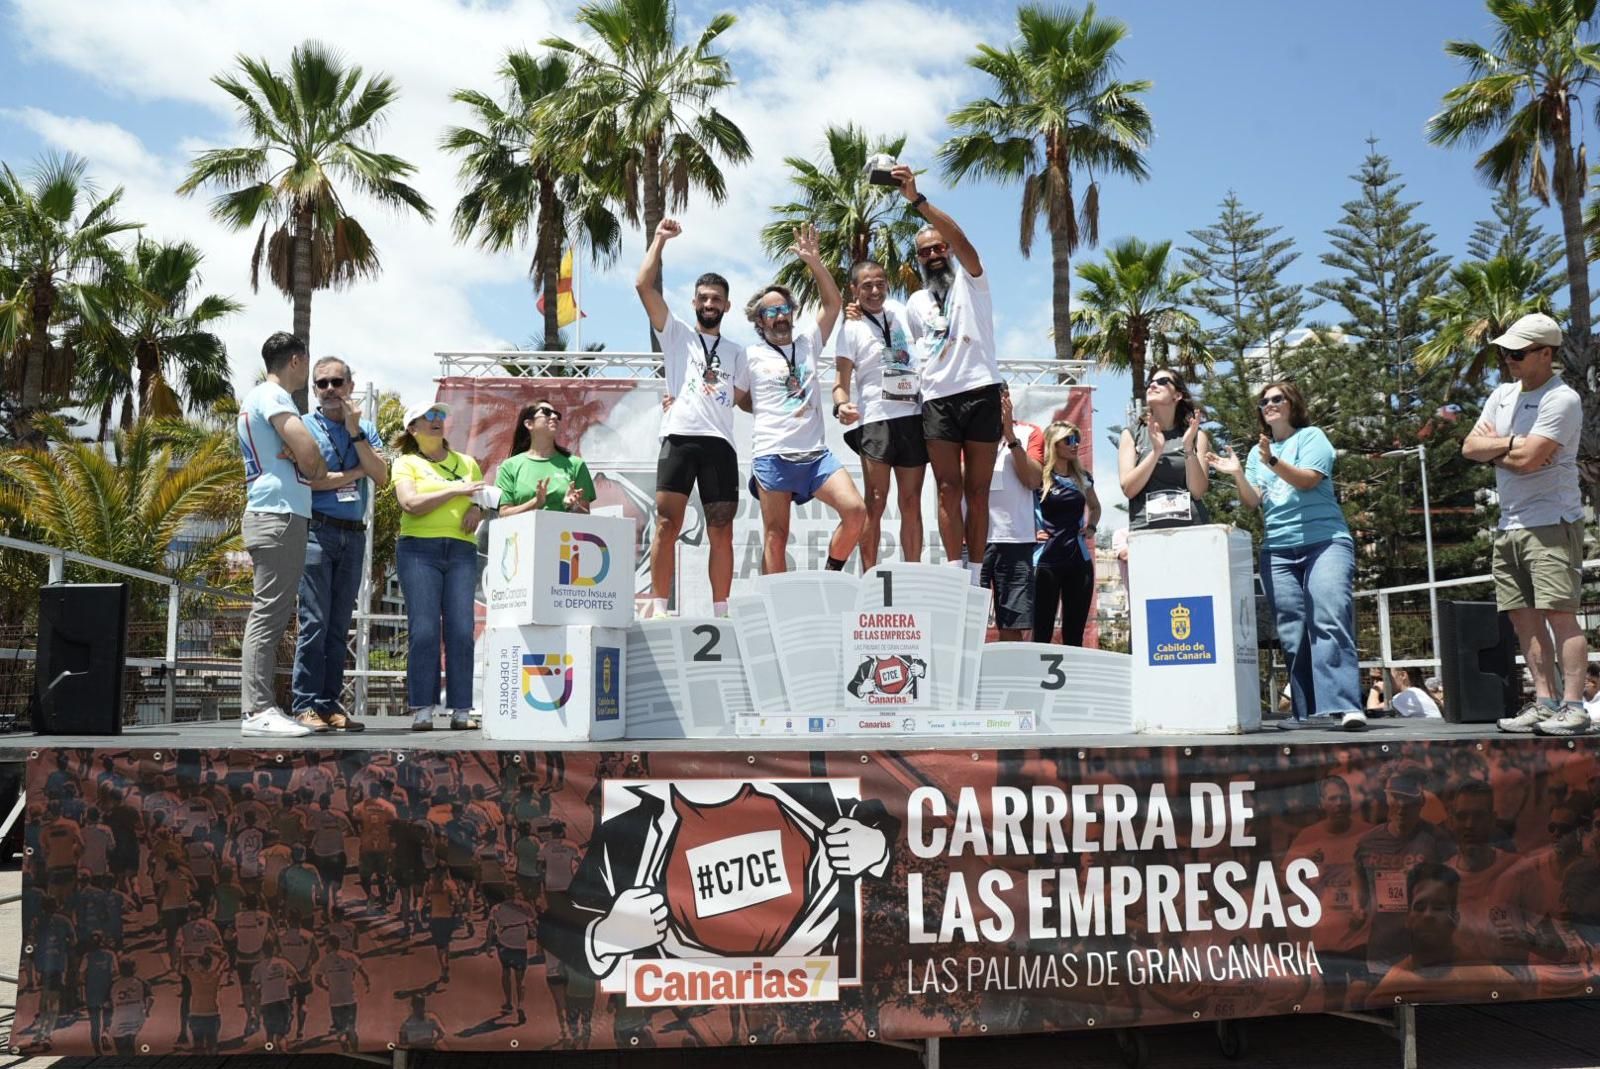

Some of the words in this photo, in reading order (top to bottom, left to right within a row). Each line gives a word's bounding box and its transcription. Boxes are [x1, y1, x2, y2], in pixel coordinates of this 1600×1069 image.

[551, 586, 586, 598] INSTITUTO
[588, 588, 617, 599] INSULAR
[553, 600, 563, 608] DE
[565, 599, 613, 611] DEPORTES
[876, 571, 892, 607] 1
[853, 630, 863, 640] DE
[864, 630, 879, 640] LAS
[880, 630, 921, 640] EMPRESAS
[859, 613, 916, 628] CARRERA
[692, 624, 722, 662] 2
[1153, 652, 1175, 661] Gran
[1176, 651, 1212, 660] Canaria
[1157, 643, 1191, 652] Cabildo
[1193, 642, 1205, 651] de
[510, 645, 520, 686] INSTITUTO
[1040, 654, 1066, 690] 3
[500, 661, 510, 716] DEPORTES
[510, 687, 520, 720] INSULAR
[986, 720, 1011, 728] Binter
[907, 783, 1178, 859] CARRERA
[1190, 781, 1257, 849] DE
[697, 849, 782, 900] #C7CE
[907, 869, 1015, 944] LAS
[1028, 858, 1322, 940] EMPRESAS
[633, 960, 832, 1003] Canarias7
[908, 957, 959, 995] LAS
[967, 953, 1078, 992] PALMAS
[1086, 950, 1120, 987] DE
[1127, 946, 1202, 985] GRAN
[1206, 940, 1324, 981] CANARIA
